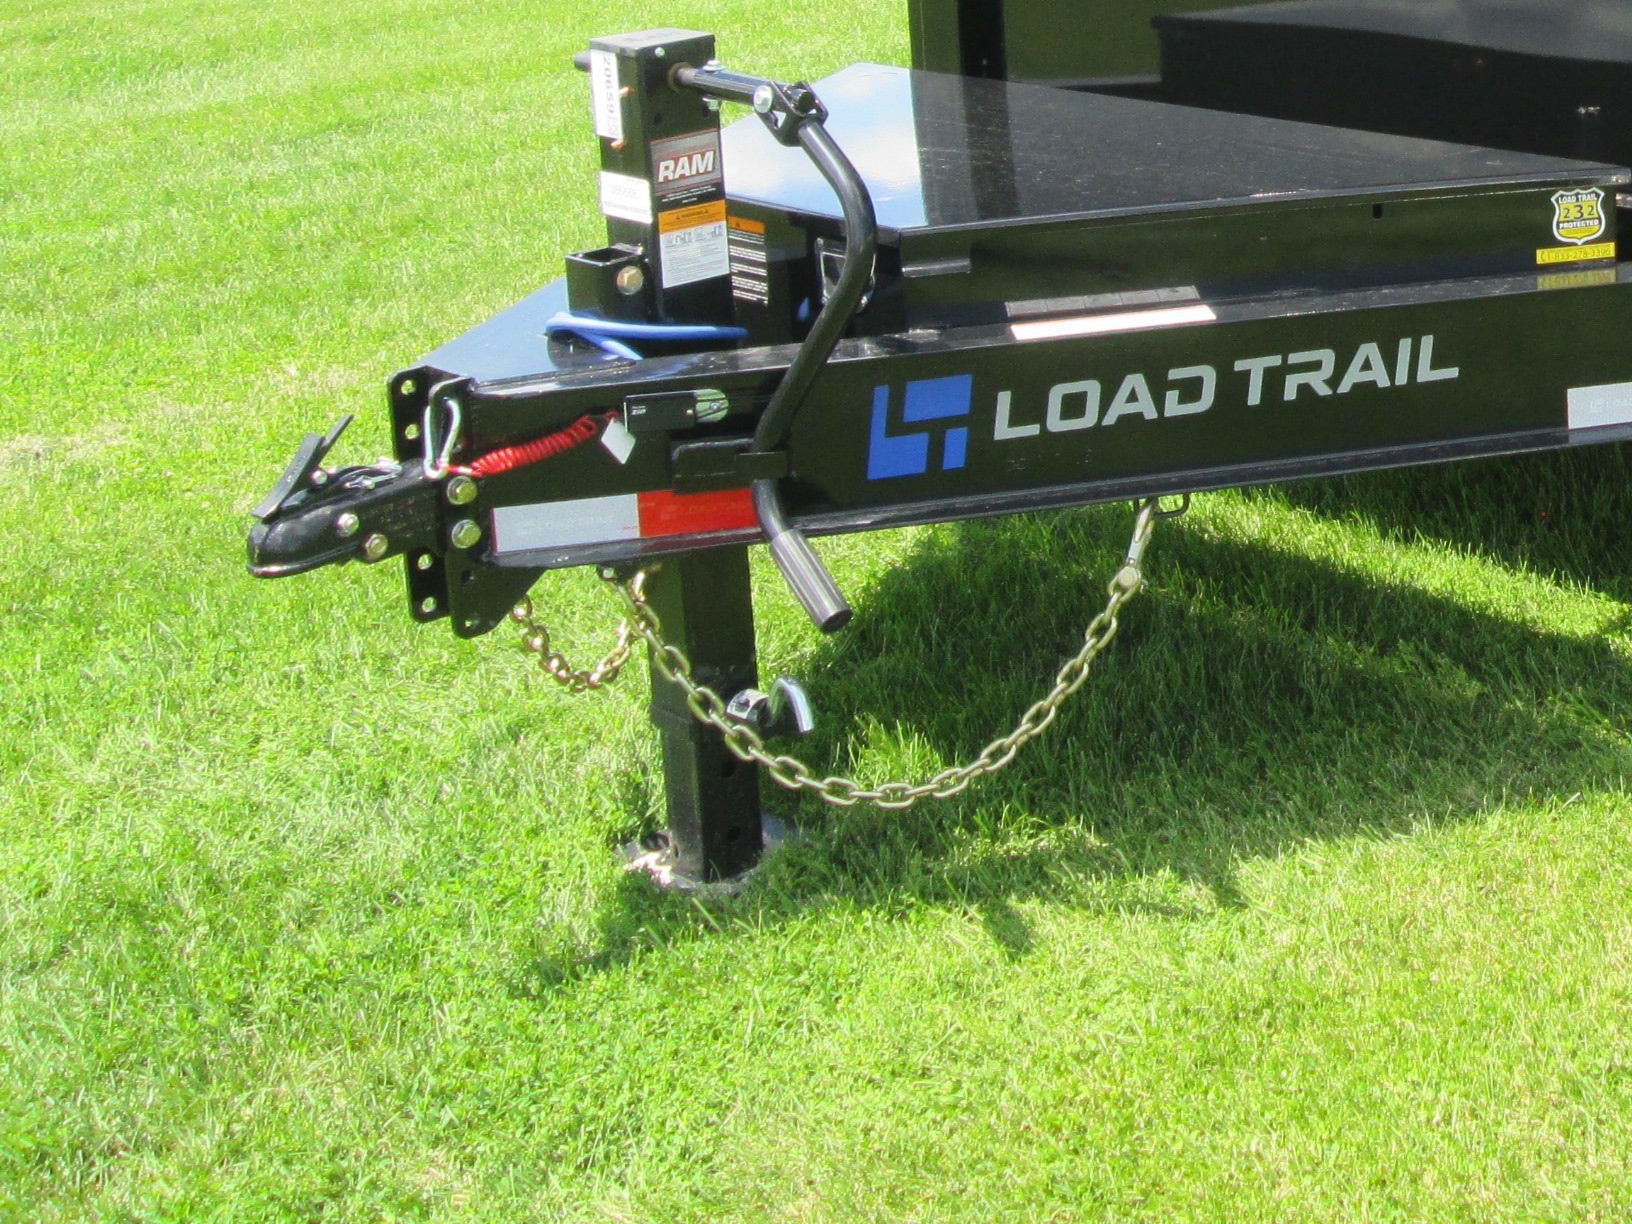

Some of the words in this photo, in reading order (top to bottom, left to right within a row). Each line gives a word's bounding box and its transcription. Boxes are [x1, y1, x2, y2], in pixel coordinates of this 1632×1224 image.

[658, 150, 715, 183] RAM
[1558, 195, 1577, 204] LOAD
[1578, 193, 1598, 202] TRAIL
[1559, 219, 1599, 230] PROTECTED
[993, 364, 1217, 441] LOAD
[1233, 334, 1460, 407] TRAIL
